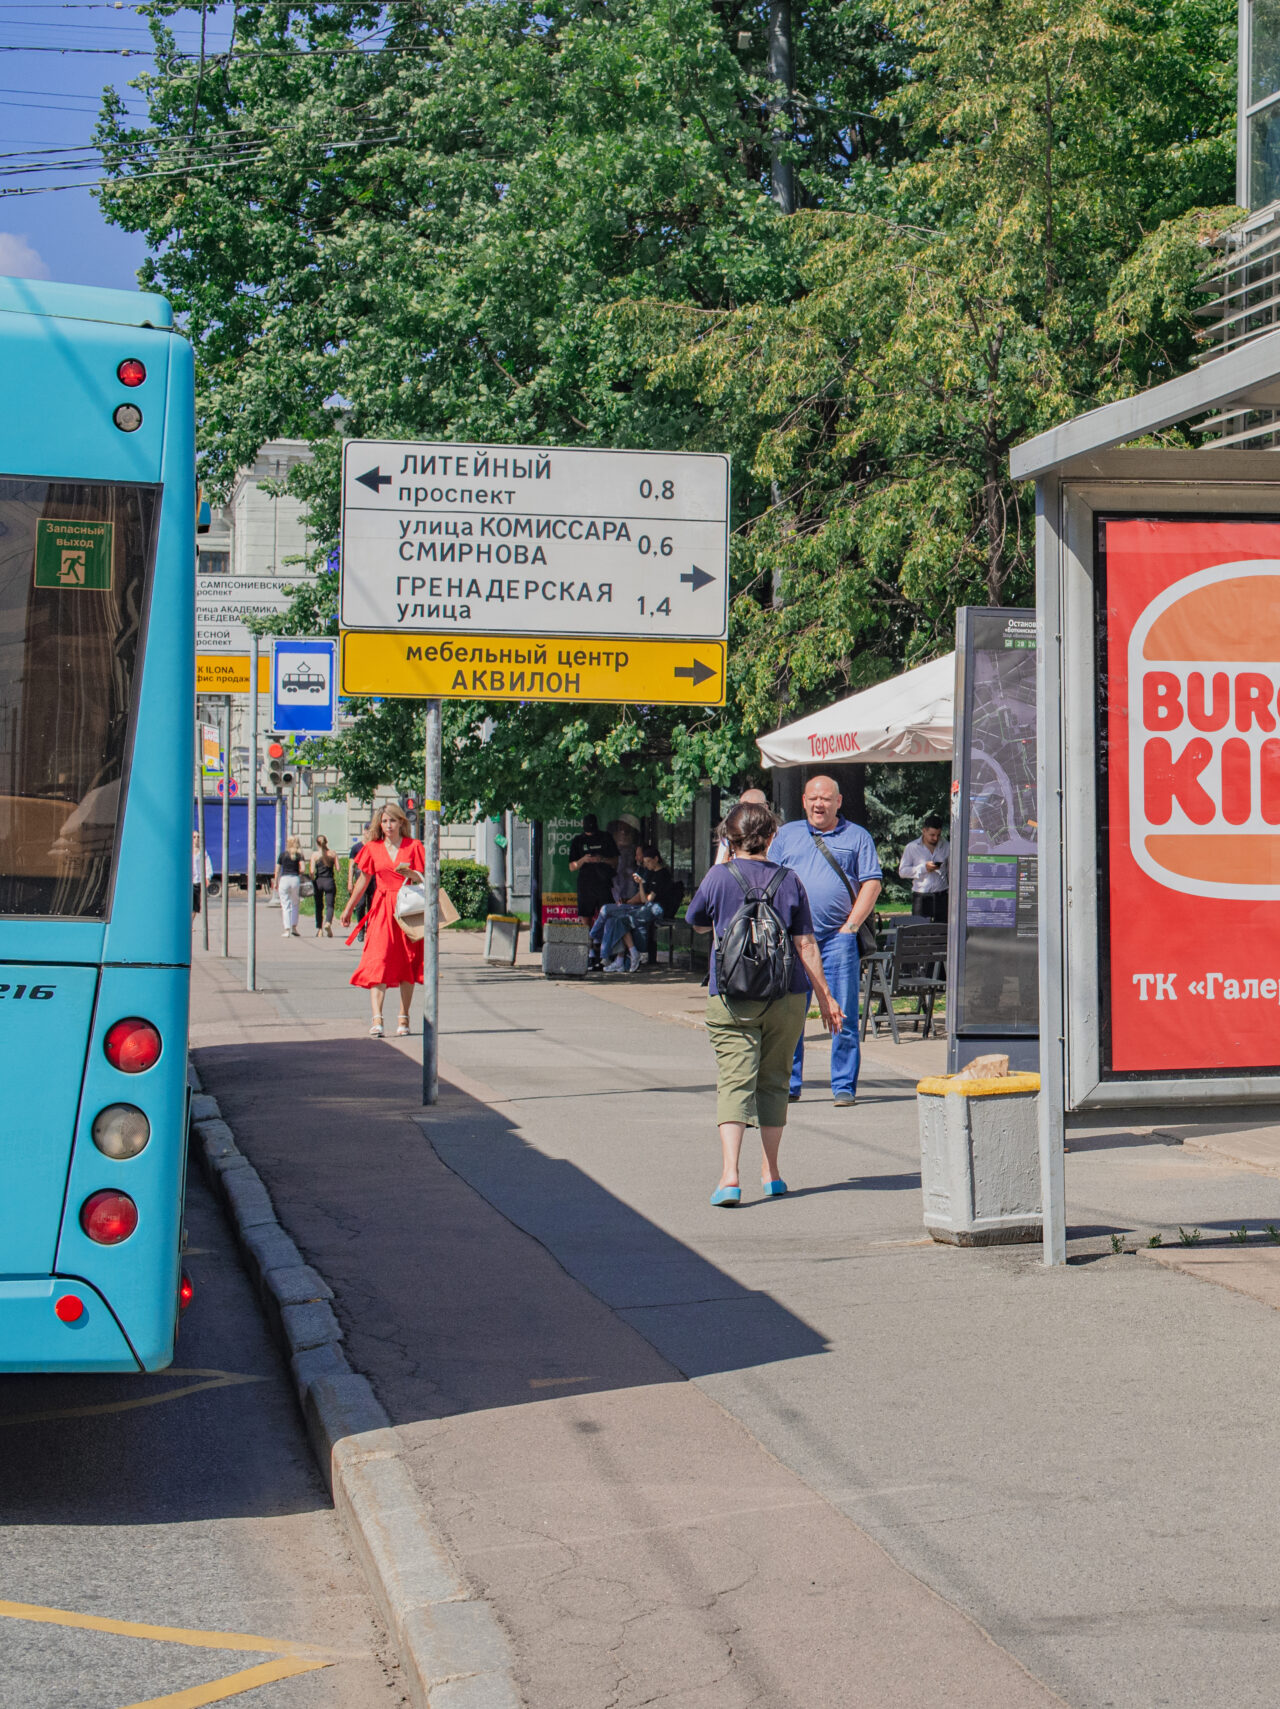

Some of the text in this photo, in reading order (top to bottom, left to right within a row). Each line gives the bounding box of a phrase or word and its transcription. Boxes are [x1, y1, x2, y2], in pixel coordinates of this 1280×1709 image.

[400, 450, 551, 480] ЛИТЕЙНЫЙ
[399, 479, 675, 507] проспект 0,8
[46, 523, 105, 535] Запасный
[398, 516, 632, 542] улица КОМИССАРА
[56, 538, 94, 549] выход
[398, 535, 674, 566] СМИРНОВА 0,6
[396, 575, 613, 602] ГРЕНАДЕРСКАЯ
[220, 605, 278, 614] АКАДЕМИКА
[396, 595, 672, 622] улица 1,4
[205, 666, 234, 674] ILONA
[405, 642, 629, 672] мебельный центр
[451, 669, 580, 693] АКВИЛОН
[807, 731, 861, 759] Теремок
[1132, 973, 1178, 1000] ТК
